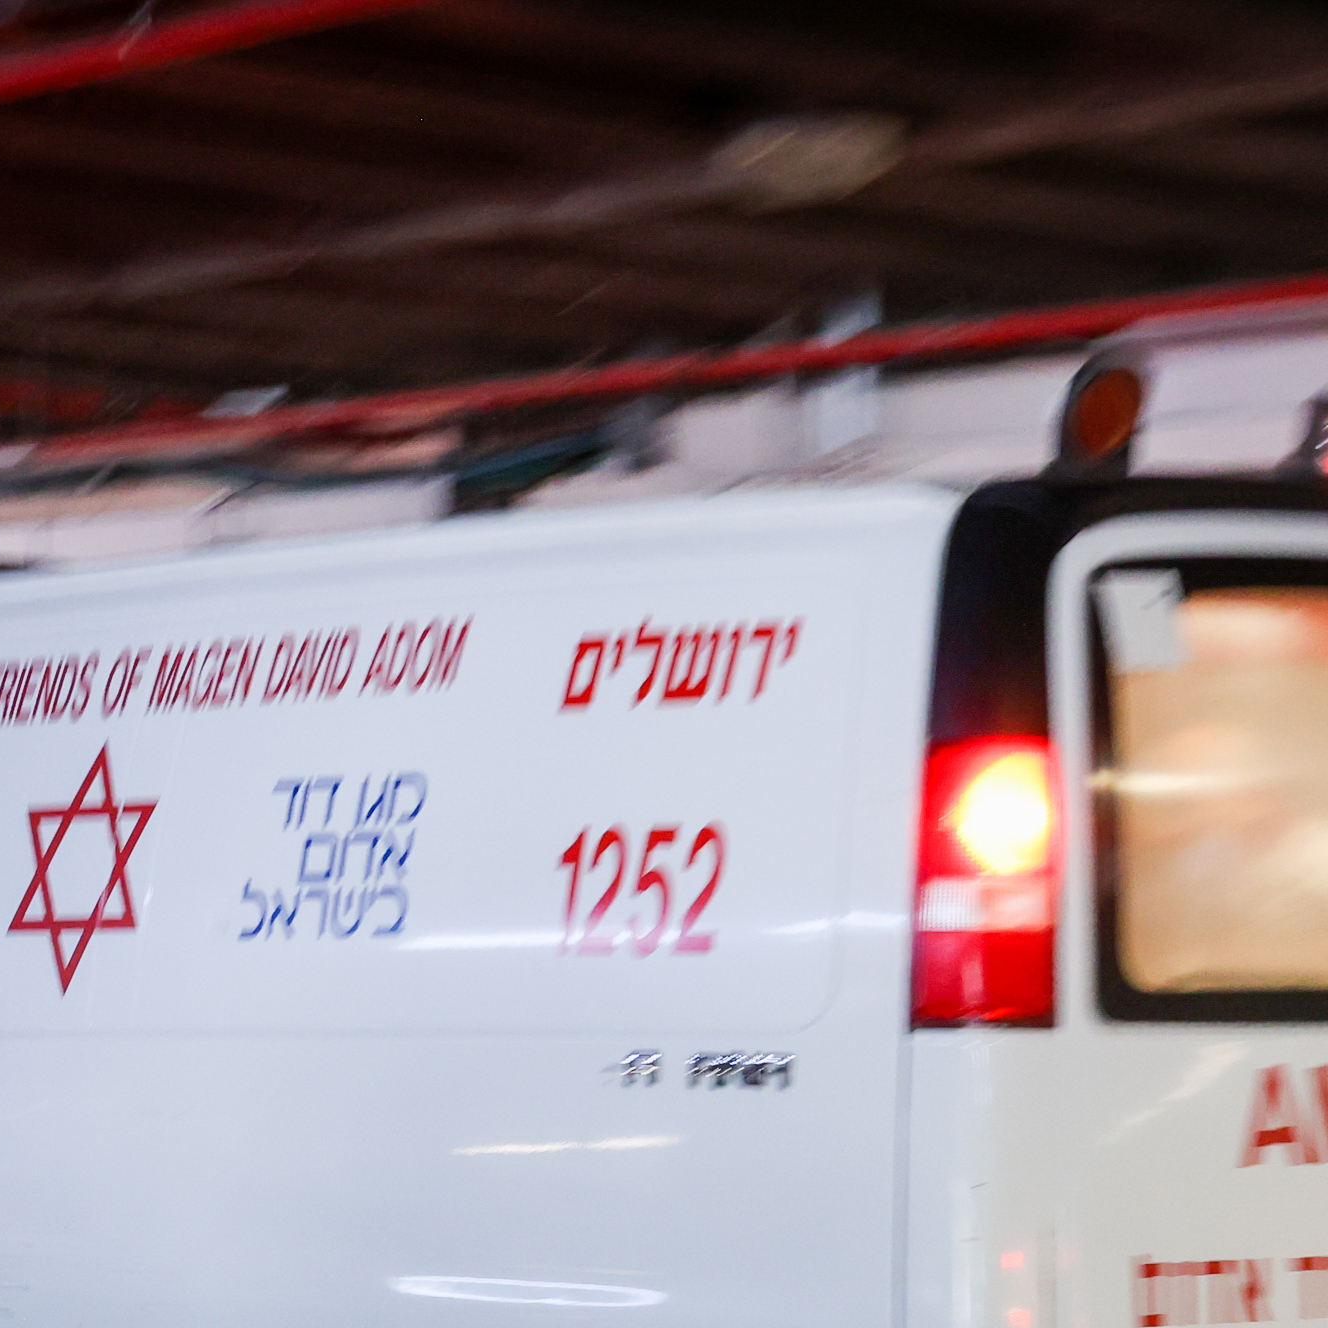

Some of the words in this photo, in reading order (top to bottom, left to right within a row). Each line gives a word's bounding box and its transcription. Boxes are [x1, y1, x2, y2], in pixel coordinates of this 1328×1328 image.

[100, 644, 153, 718] OF
[145, 634, 267, 716] MAGEN
[260, 626, 360, 706] DAVID
[361, 612, 474, 699] ADOM
[556, 614, 806, 716] ירושלים
[271, 774, 345, 833] דוד
[297, 827, 416, 886] אדום
[556, 820, 727, 961] 1252
